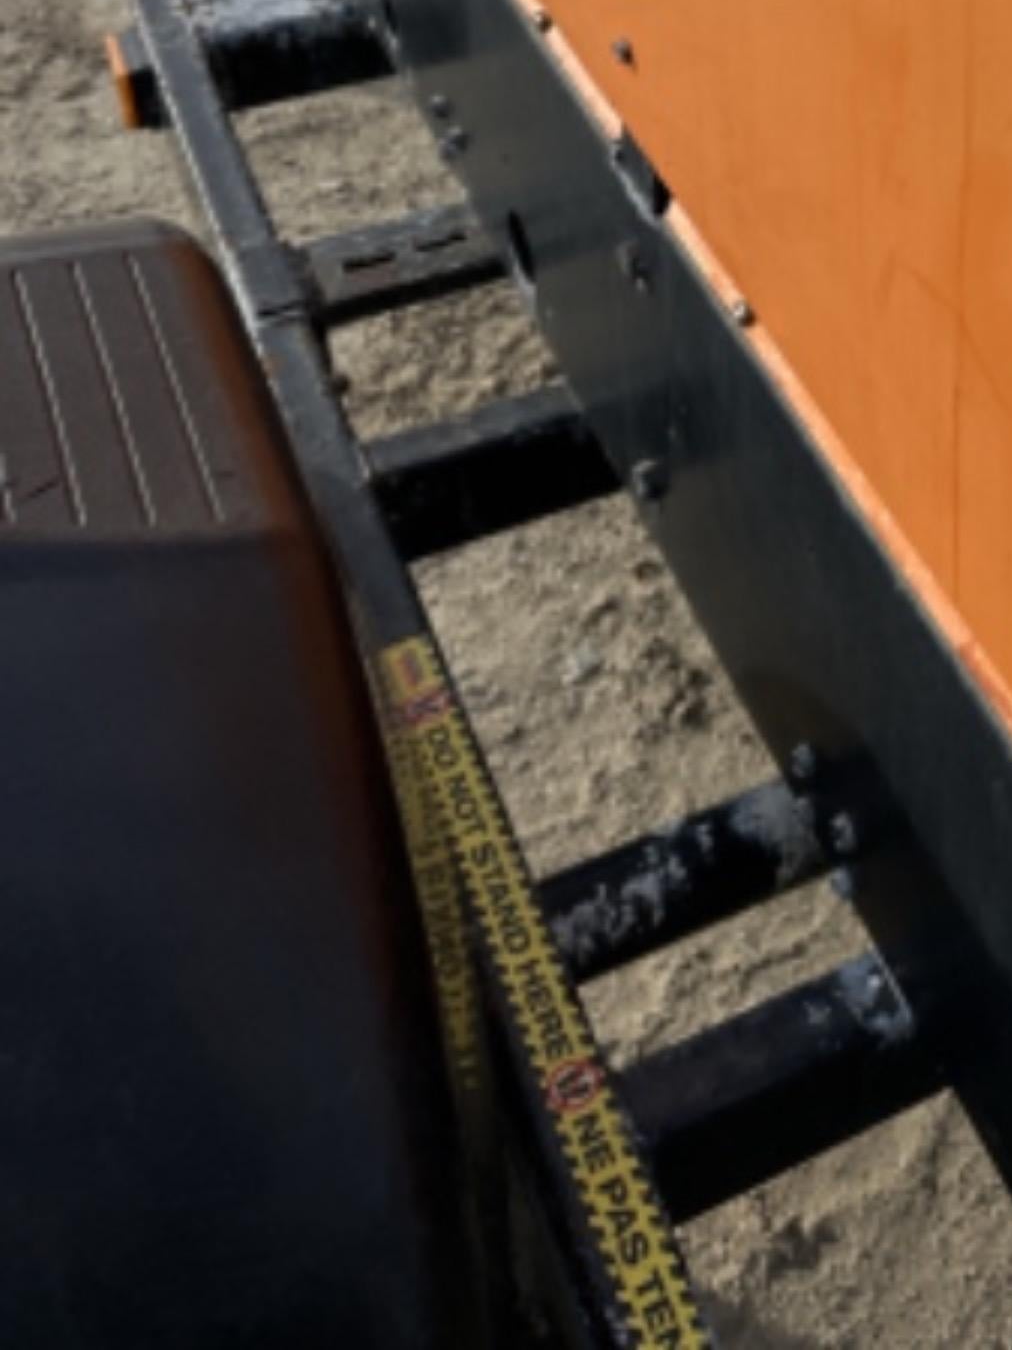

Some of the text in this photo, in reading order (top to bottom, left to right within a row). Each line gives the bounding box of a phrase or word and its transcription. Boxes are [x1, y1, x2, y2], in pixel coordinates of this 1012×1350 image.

[446, 774, 489, 836] NOT
[469, 842, 532, 954] STAND
[521, 957, 574, 1061] HERE
[572, 1113, 617, 1173] NE
[597, 1175, 649, 1266] PAS
